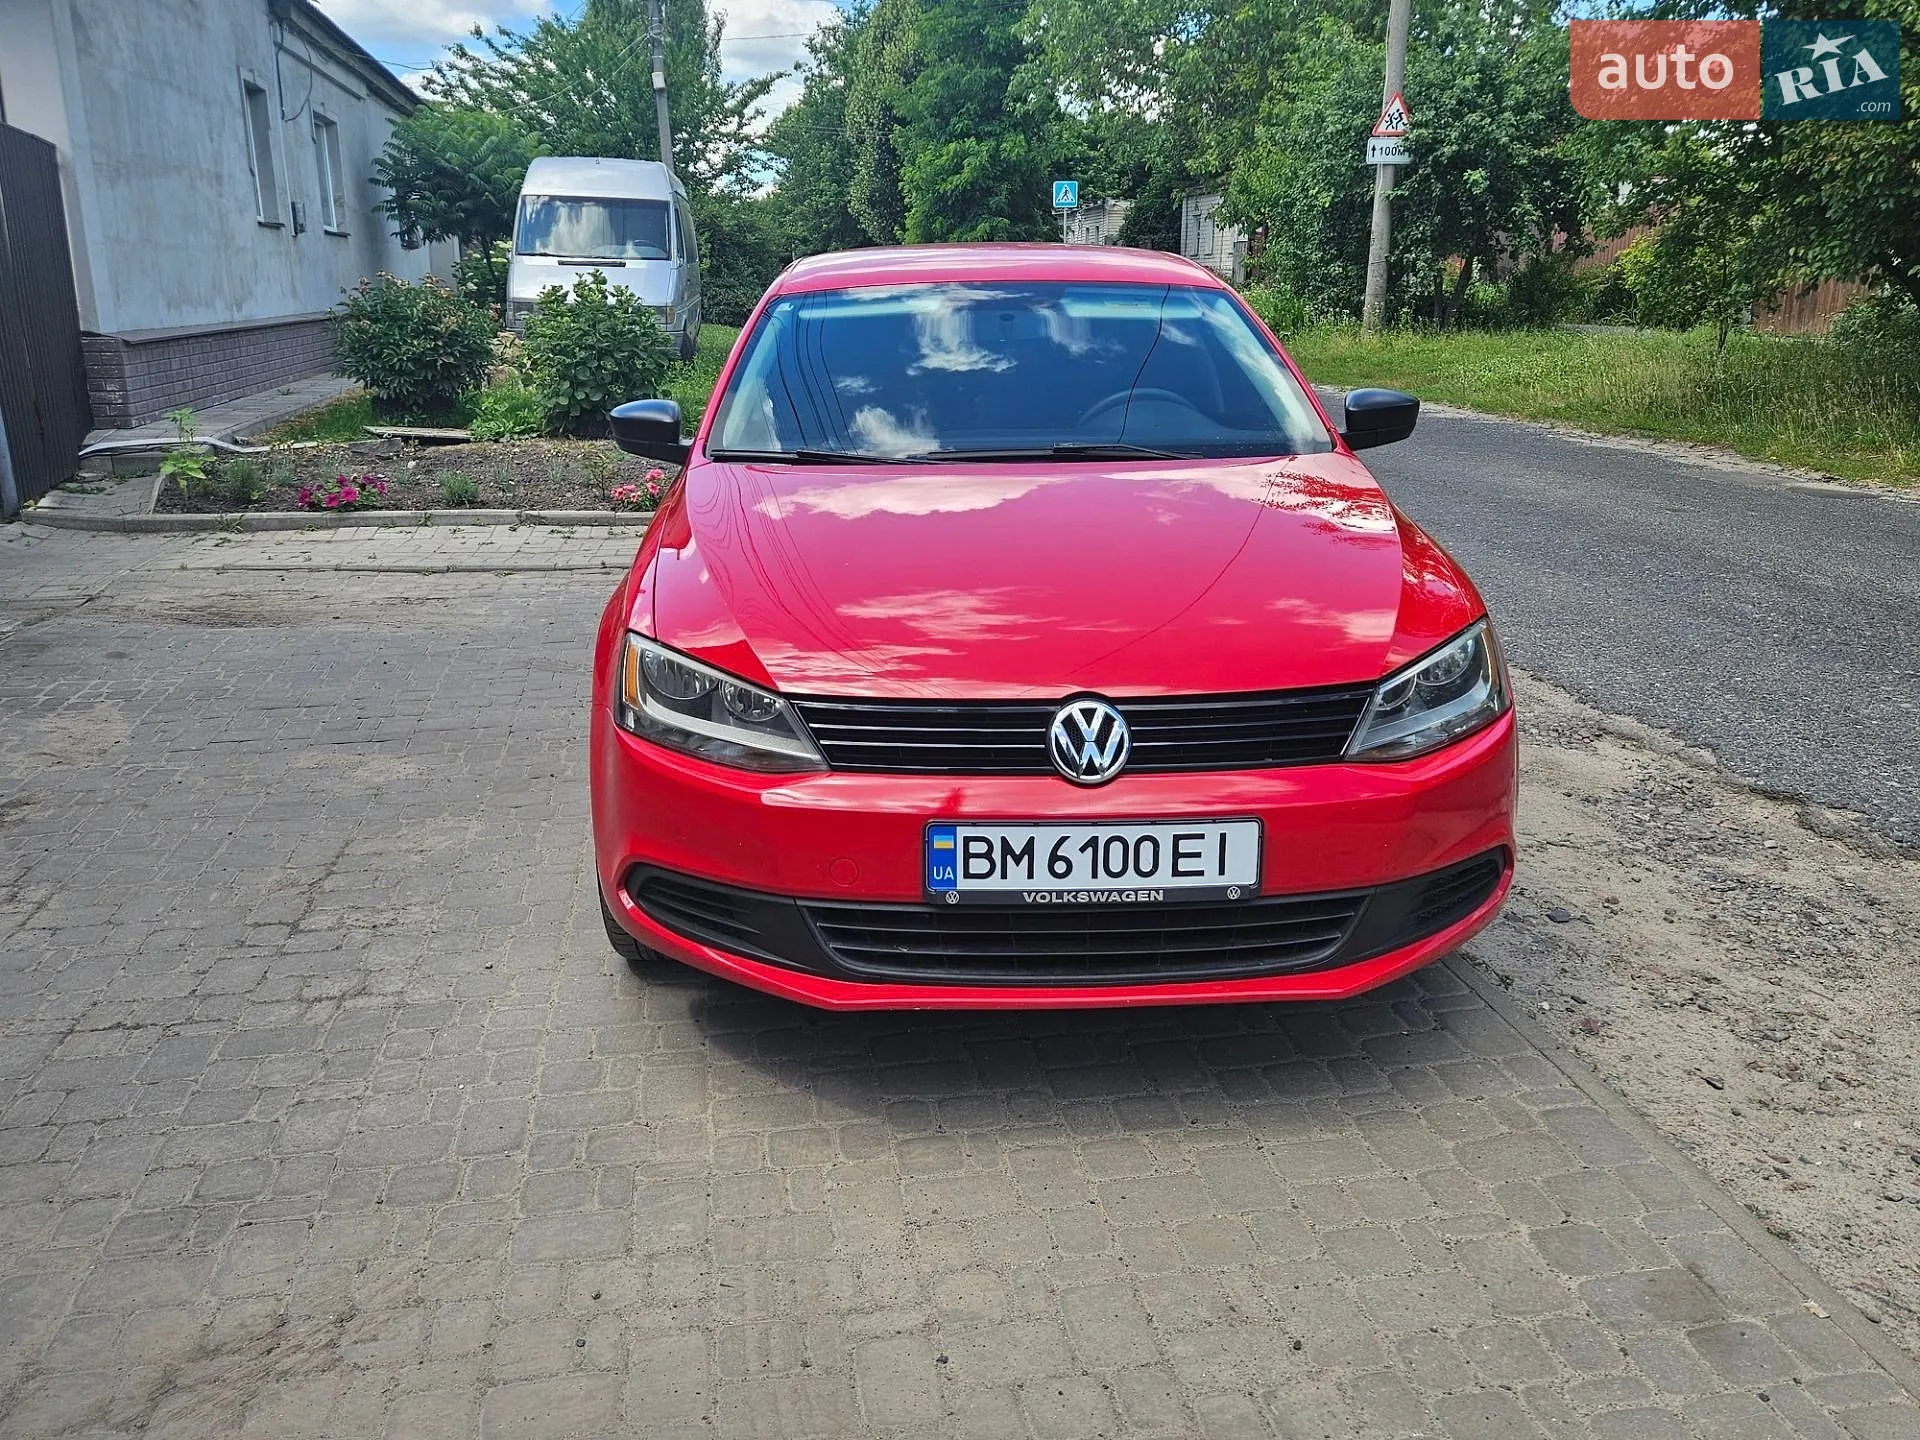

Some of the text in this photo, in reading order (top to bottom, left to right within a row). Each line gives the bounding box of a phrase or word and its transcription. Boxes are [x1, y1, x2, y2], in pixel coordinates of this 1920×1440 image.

[962, 832, 1227, 880] BM 6100 EI
[933, 865, 954, 881] UA
[1022, 889, 1164, 904] VOLKSWAGEN
